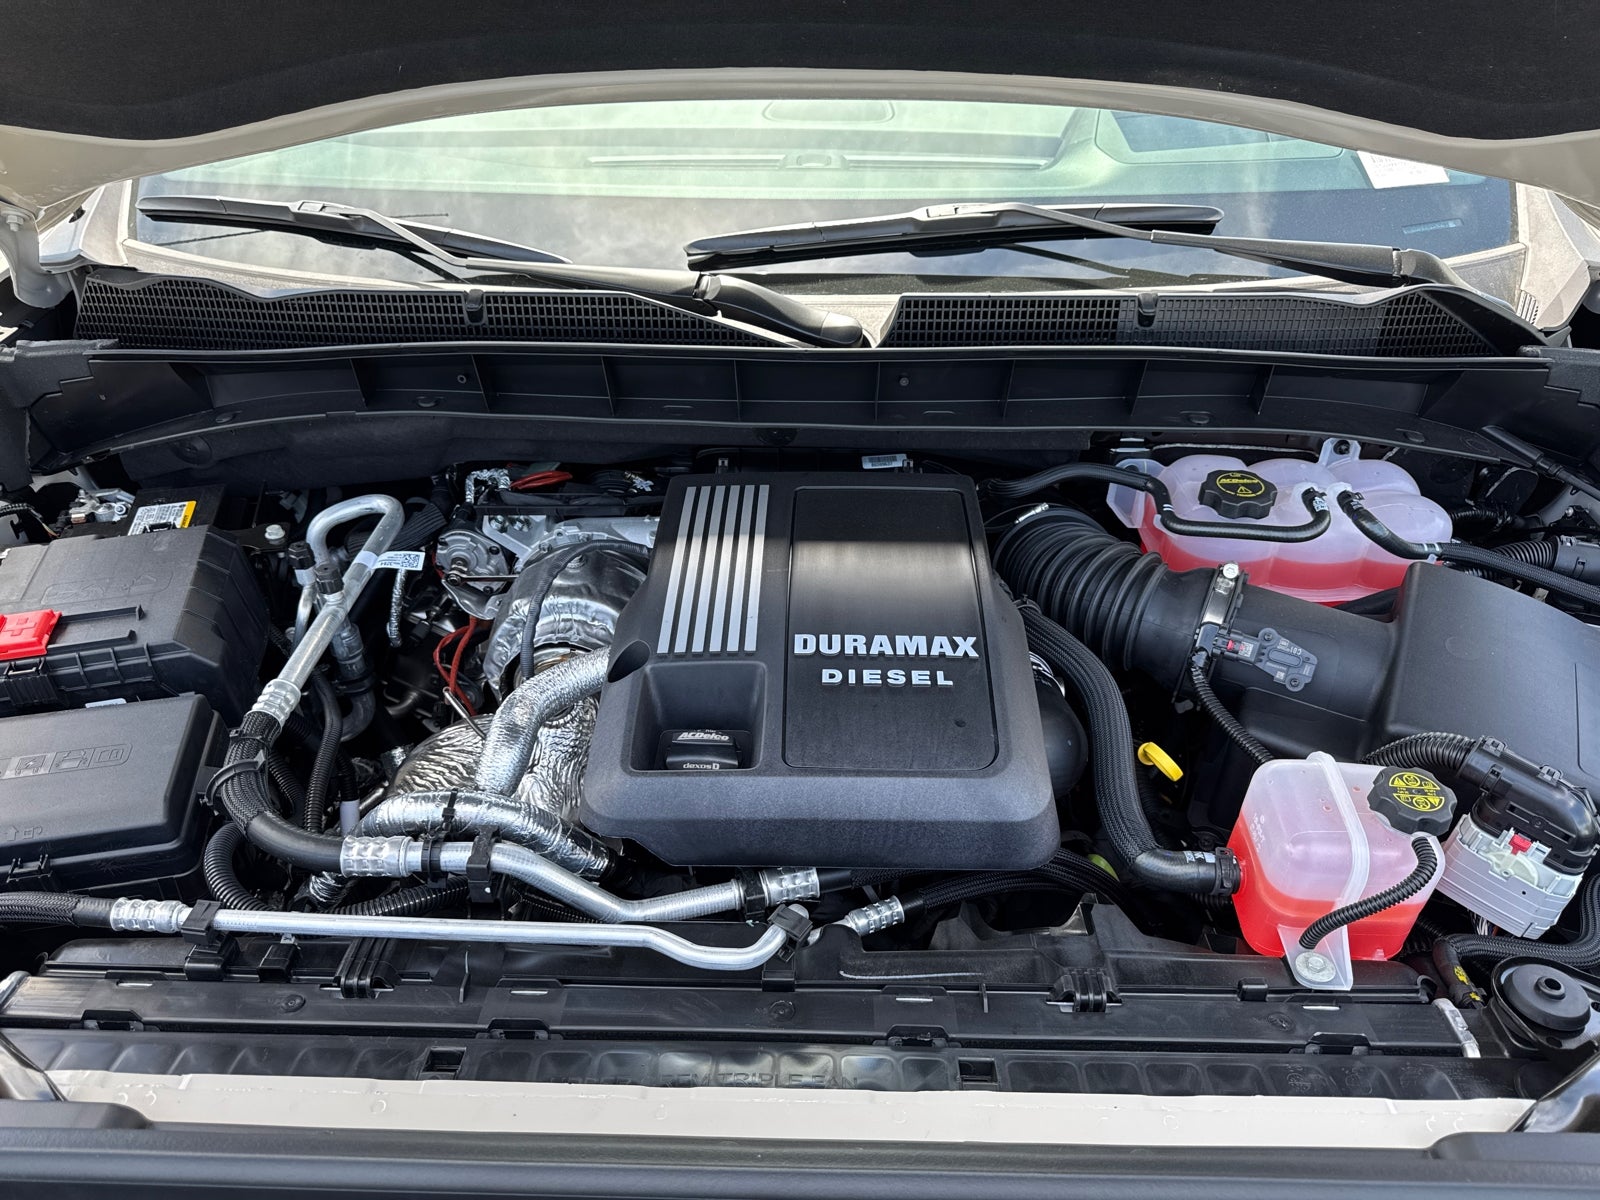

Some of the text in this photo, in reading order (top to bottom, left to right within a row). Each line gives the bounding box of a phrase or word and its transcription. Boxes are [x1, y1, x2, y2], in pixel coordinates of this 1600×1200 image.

[794, 634, 979, 657] DURAMAX
[822, 669, 953, 686] DIESEL
[677, 732, 730, 741] ACDelco
[717, 1072, 803, 1088] TRIPLE
